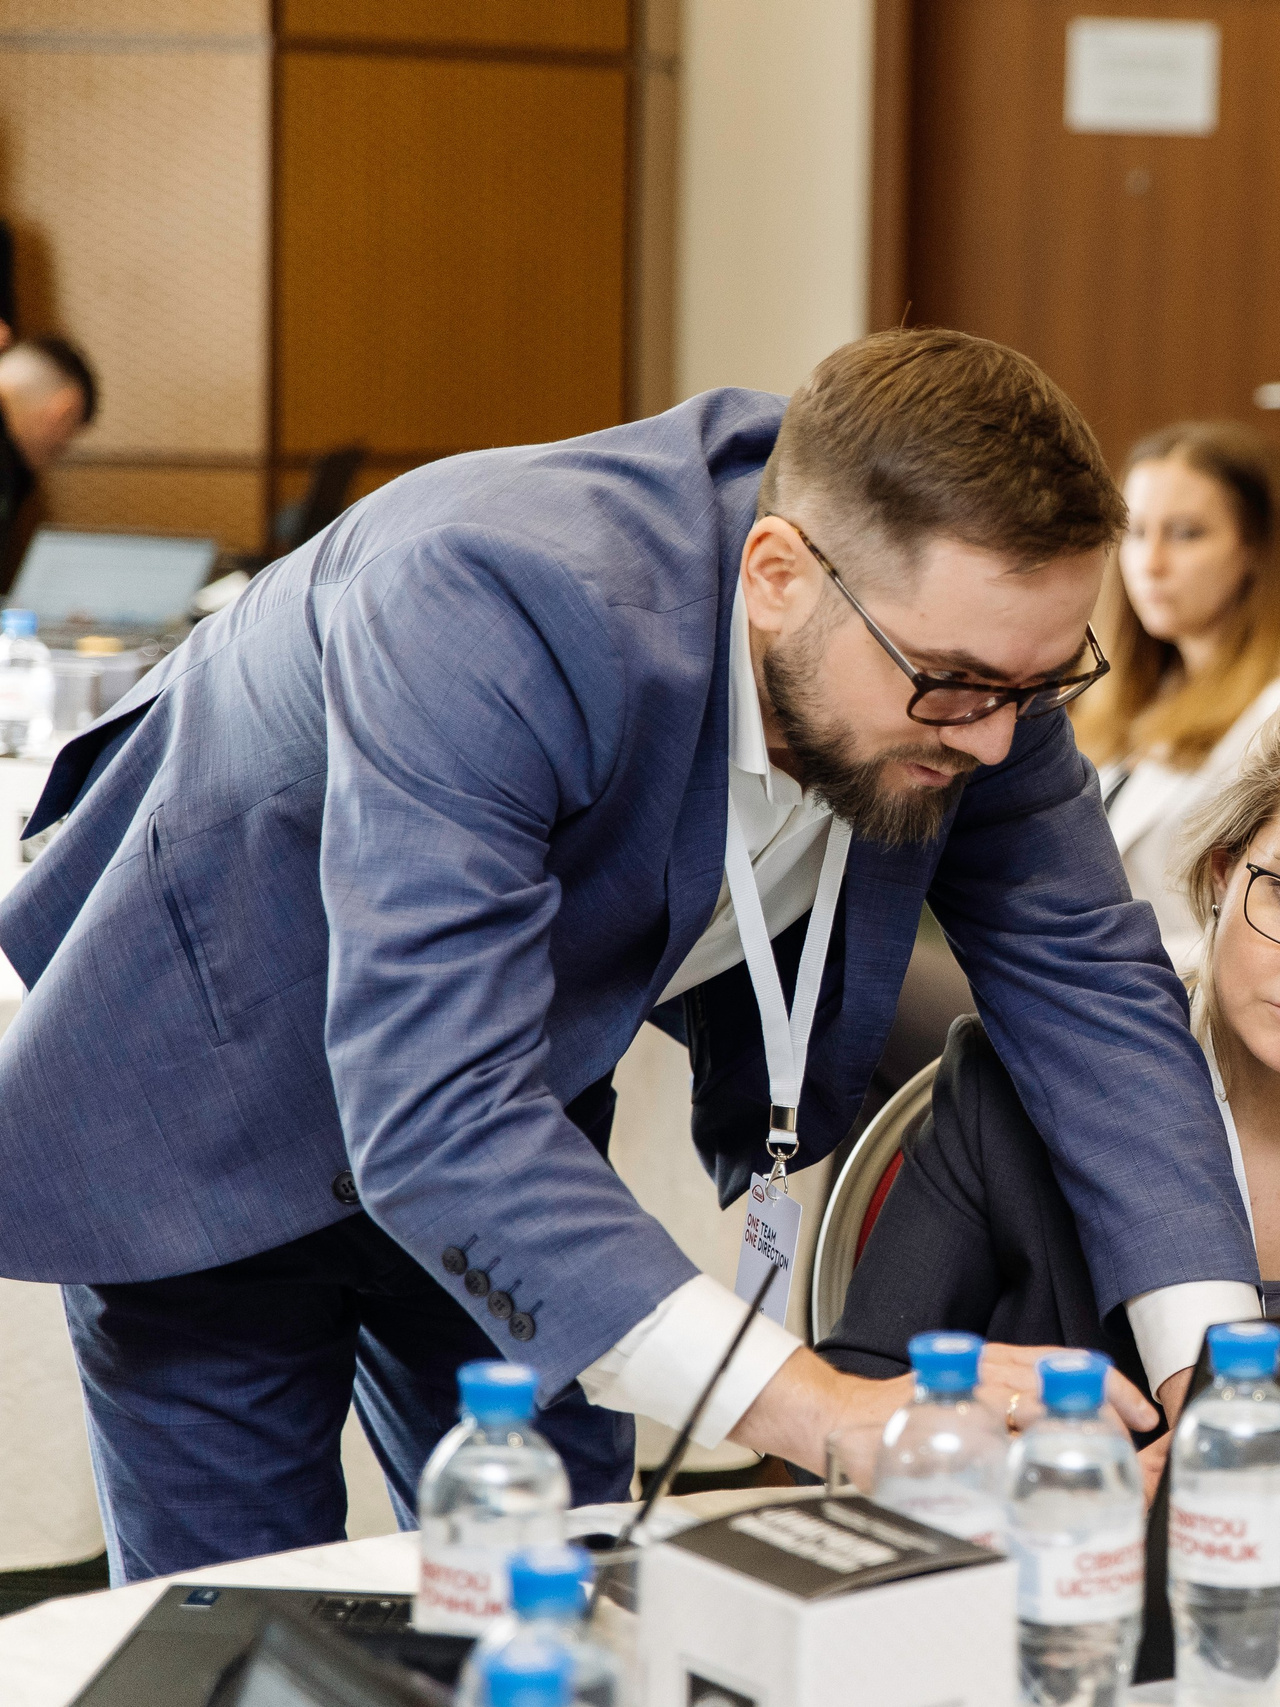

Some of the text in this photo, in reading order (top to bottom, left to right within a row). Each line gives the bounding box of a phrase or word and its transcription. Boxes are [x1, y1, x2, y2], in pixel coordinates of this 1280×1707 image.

[747, 1213, 777, 1245] ONE TEAM
[744, 1229, 789, 1271] ONE DIRECTION
